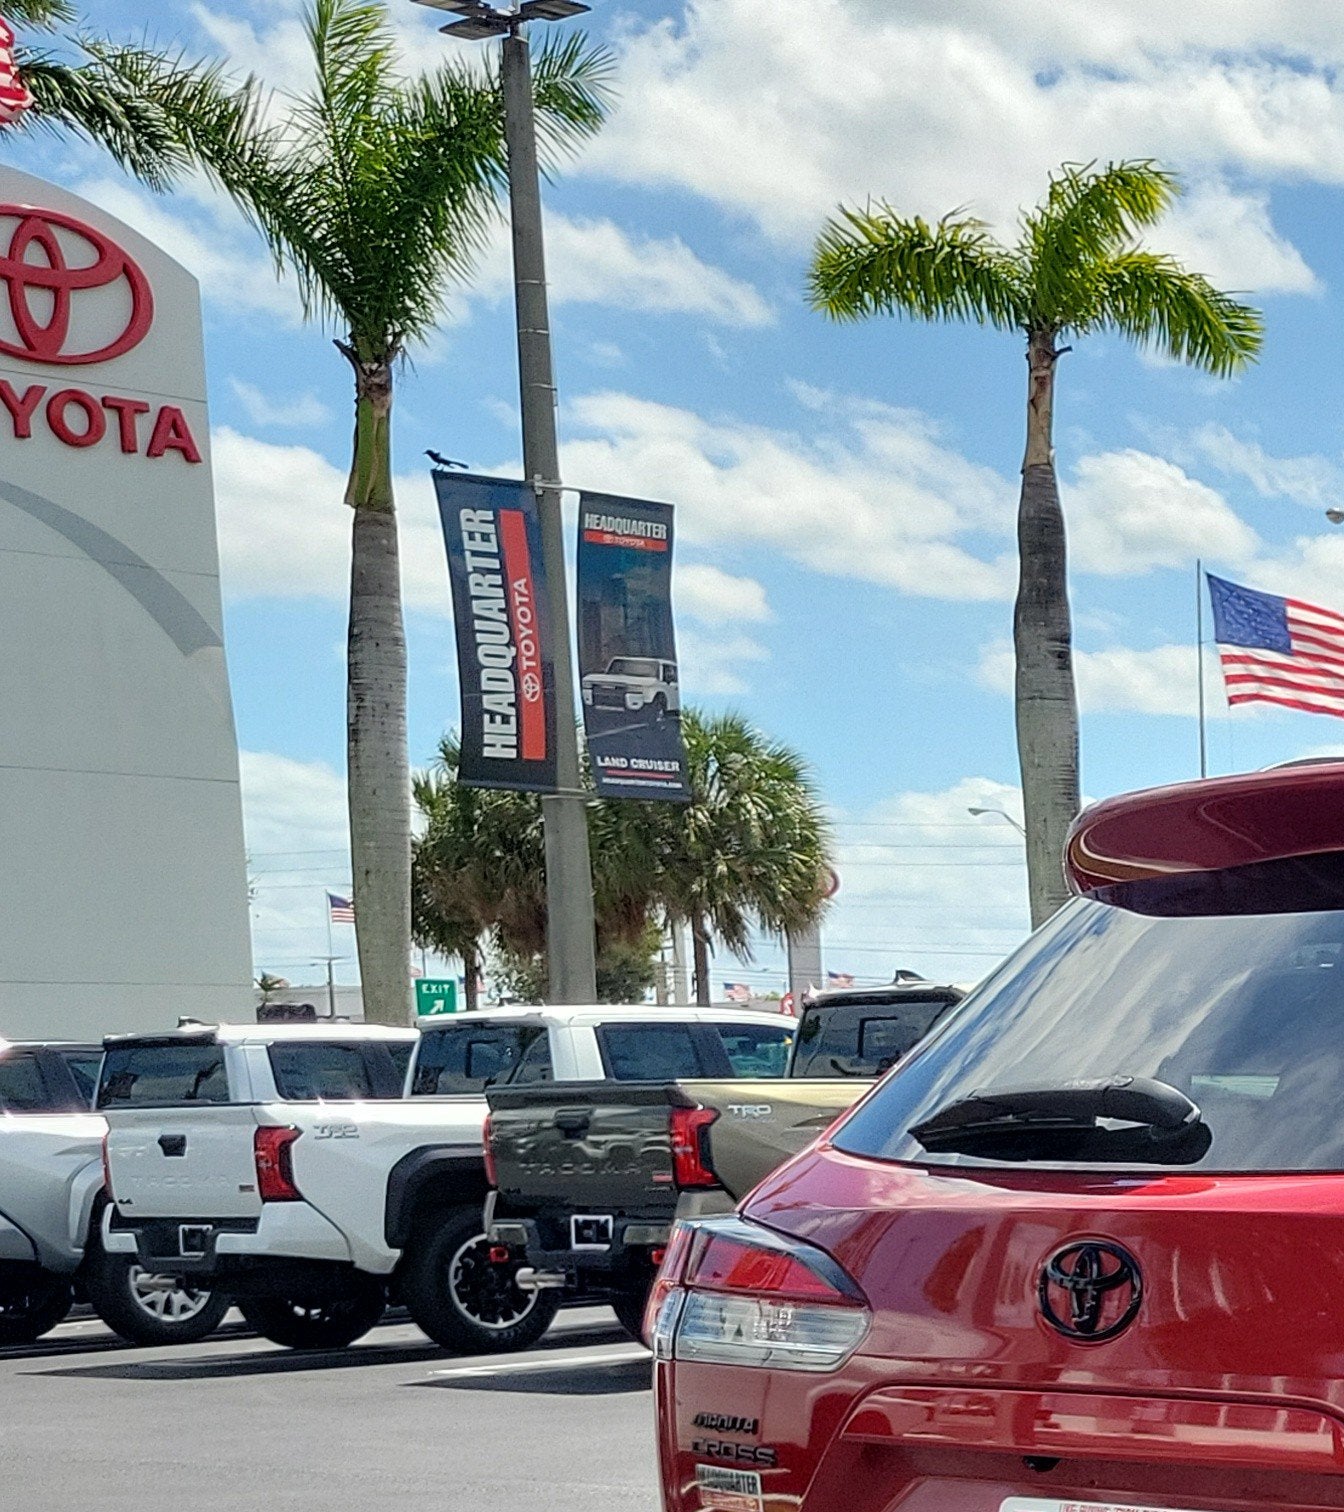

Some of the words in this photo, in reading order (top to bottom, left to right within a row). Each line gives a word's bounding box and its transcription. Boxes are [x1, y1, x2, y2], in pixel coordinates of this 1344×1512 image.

[584, 512, 667, 540] HEADQUARTER
[459, 508, 518, 759] HEADQUARTER
[512, 578, 541, 669] TOYOTA
[596, 755, 628, 769] LAND
[630, 758, 680, 773] CRUISER
[421, 983, 450, 995] EXIT
[692, 1438, 777, 1467] CROSS
